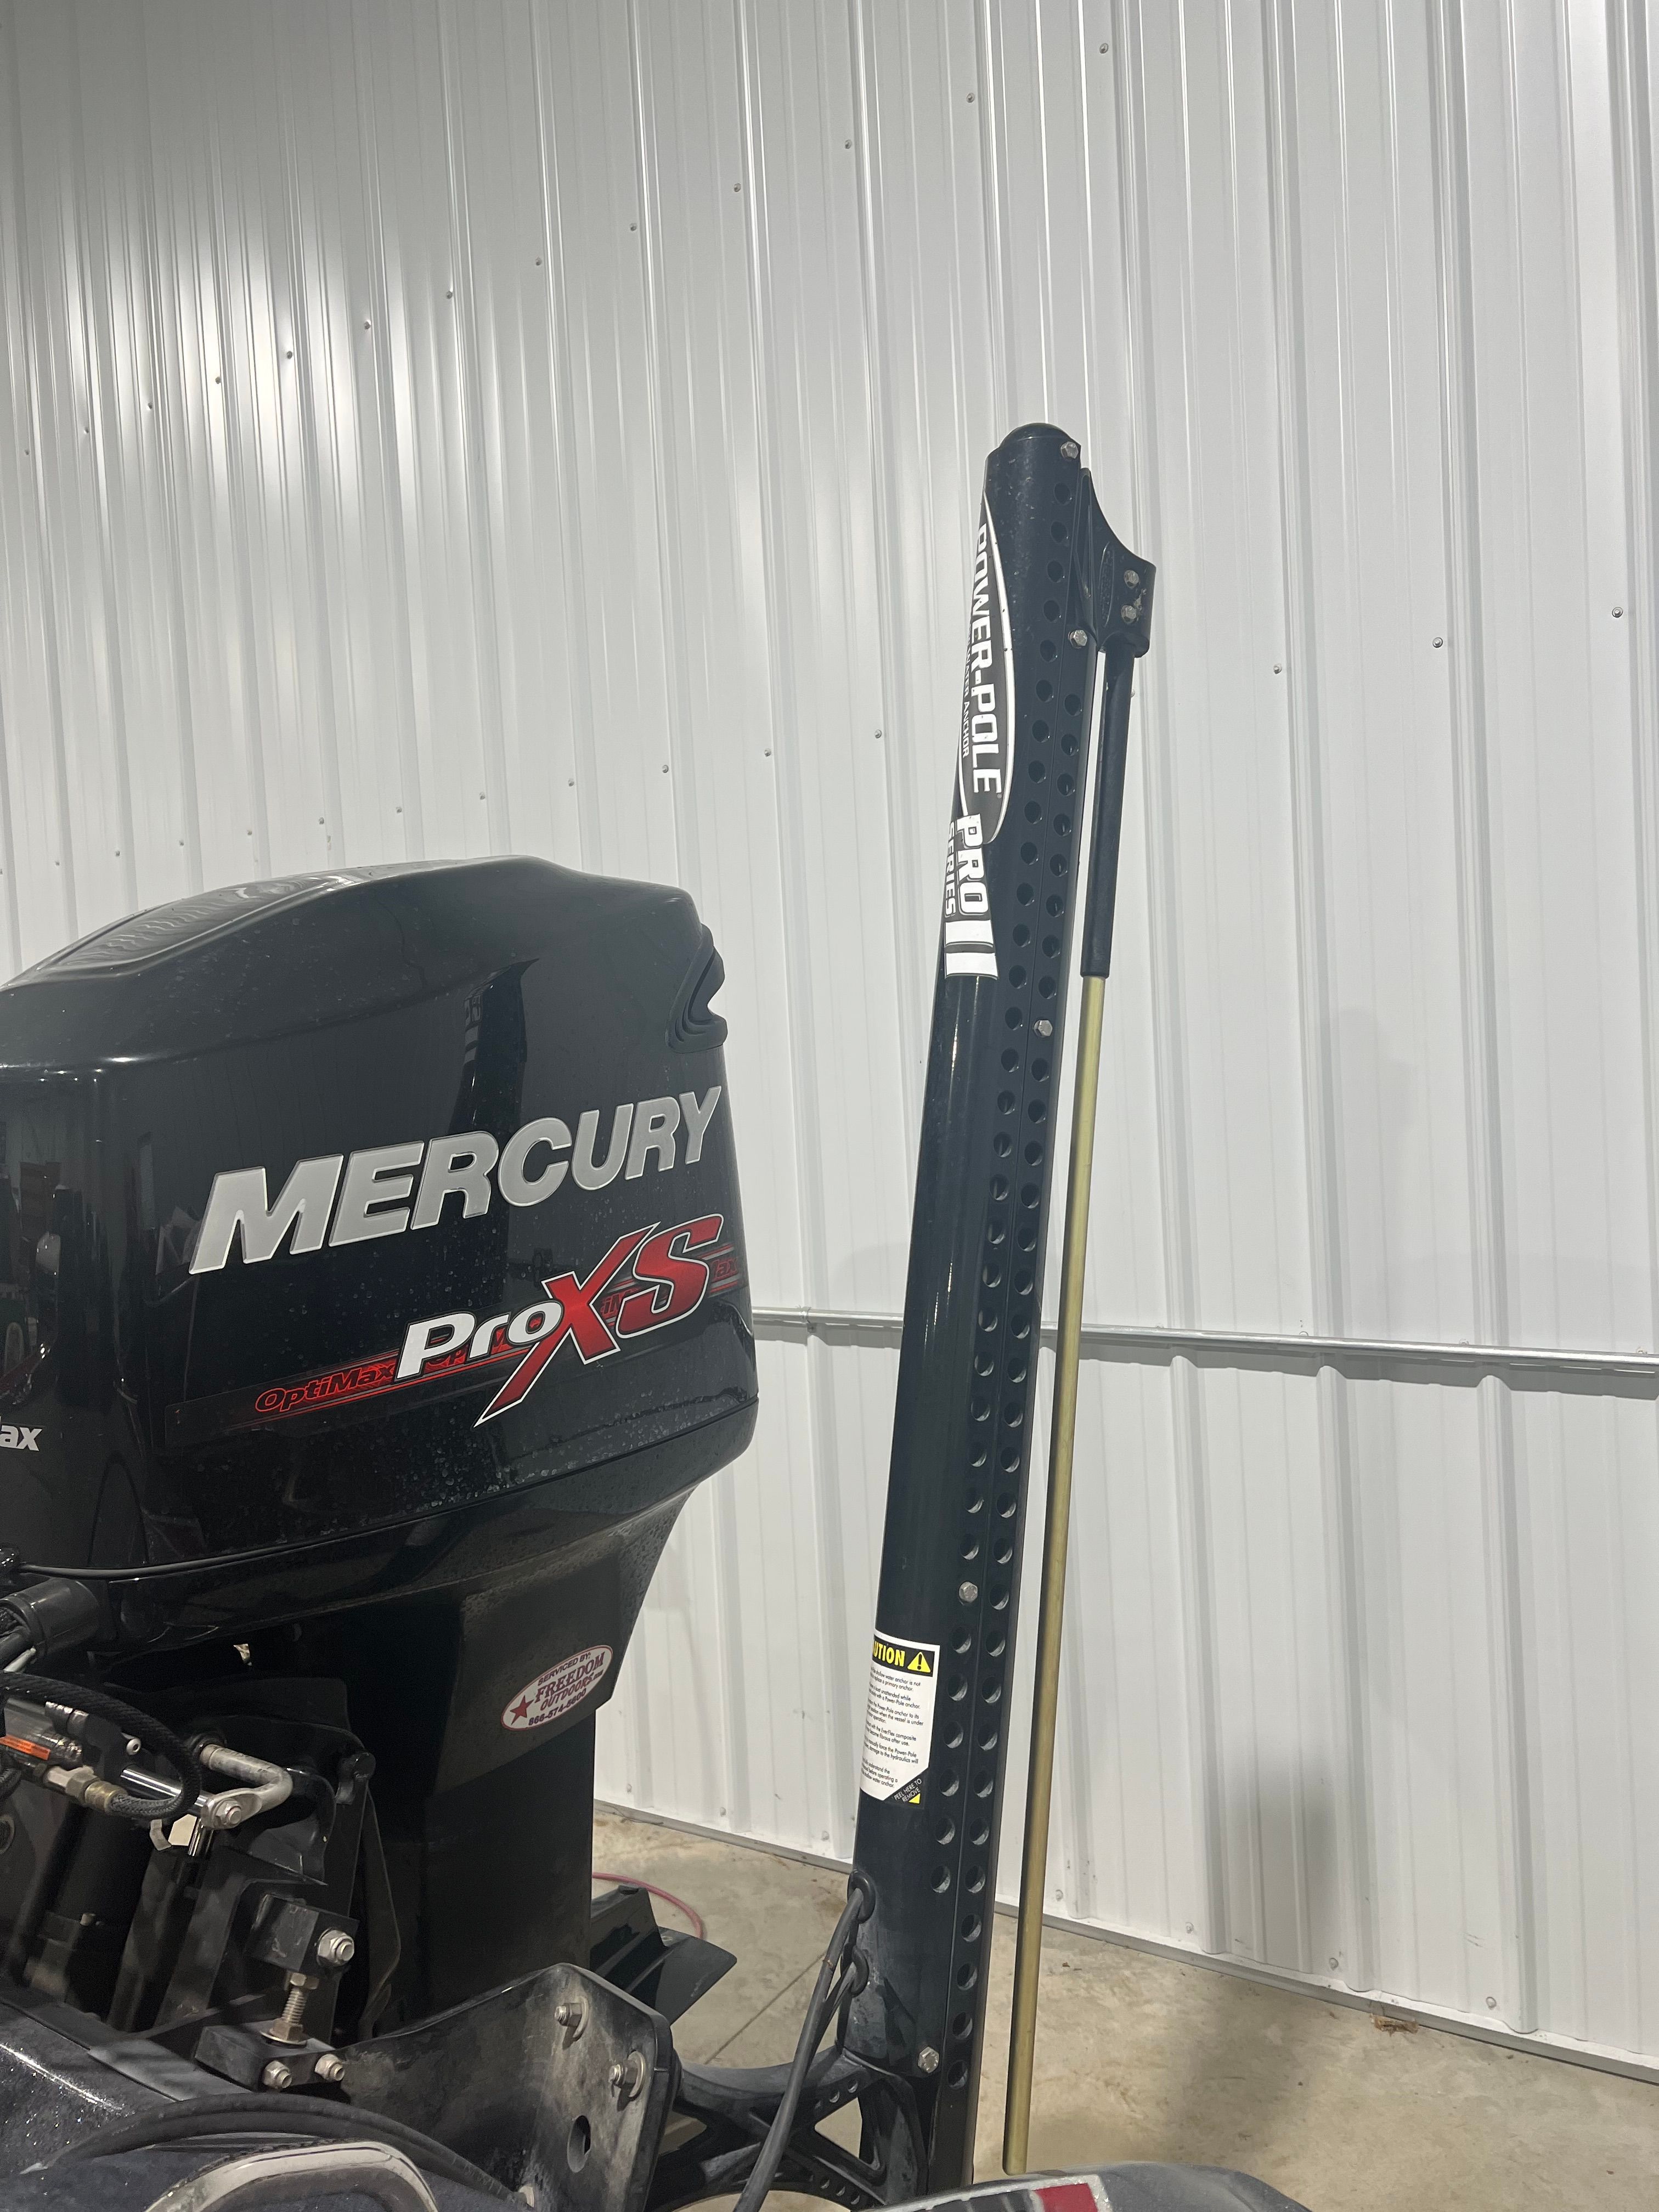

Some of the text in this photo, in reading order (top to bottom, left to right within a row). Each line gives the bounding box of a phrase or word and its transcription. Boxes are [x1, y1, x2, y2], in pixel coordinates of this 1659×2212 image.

[945, 821, 956, 918] SERIES
[956, 813, 989, 915] PRO
[189, 1086, 722, 1274] MERCURY
[255, 1363, 396, 1413] OptiMax
[0, 1416, 43, 1452] ax
[538, 1657, 578, 1686] SERVICED
[873, 1640, 905, 1667] UTION
[534, 1651, 605, 1703] FREEDOM
[540, 1672, 594, 1711] OUTDOORS
[890, 1754, 910, 1763] hydraulics
[877, 1773, 894, 1782] operating
[894, 1791, 904, 1801] PEEL
[903, 1783, 916, 1793] HERE
[901, 1787, 921, 1803] REMOVE
